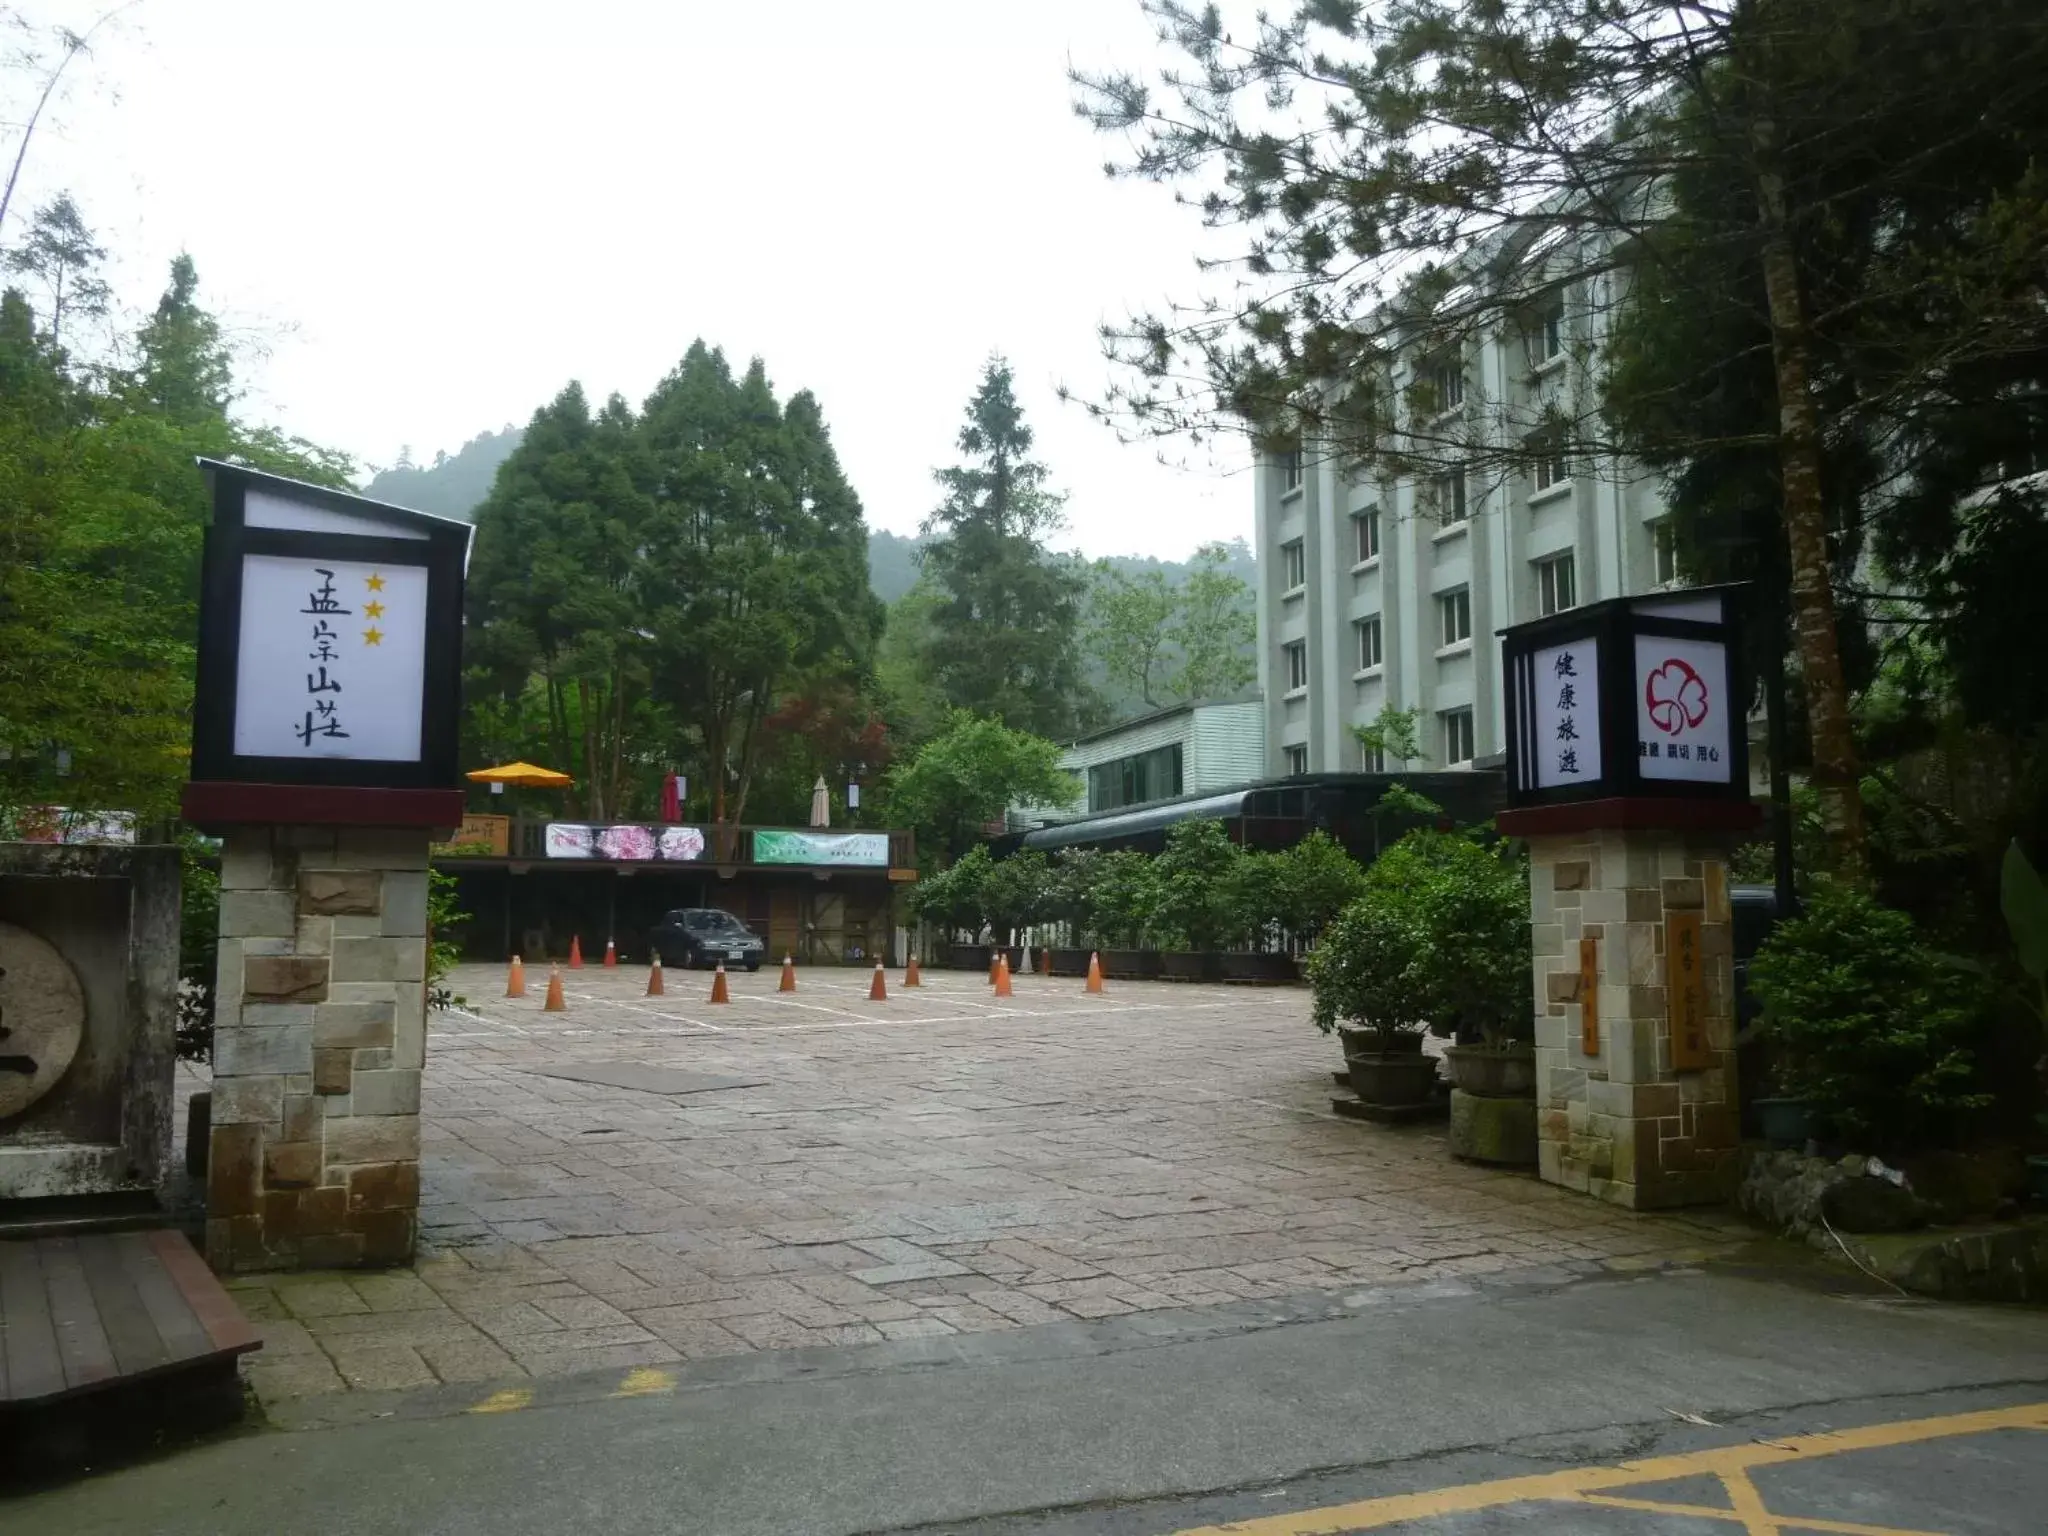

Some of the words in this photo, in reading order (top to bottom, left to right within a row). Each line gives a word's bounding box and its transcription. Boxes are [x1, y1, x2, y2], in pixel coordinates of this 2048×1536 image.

[1554, 651, 1579, 774] 健康旅遊
[1696, 746, 1720, 762] 用心
